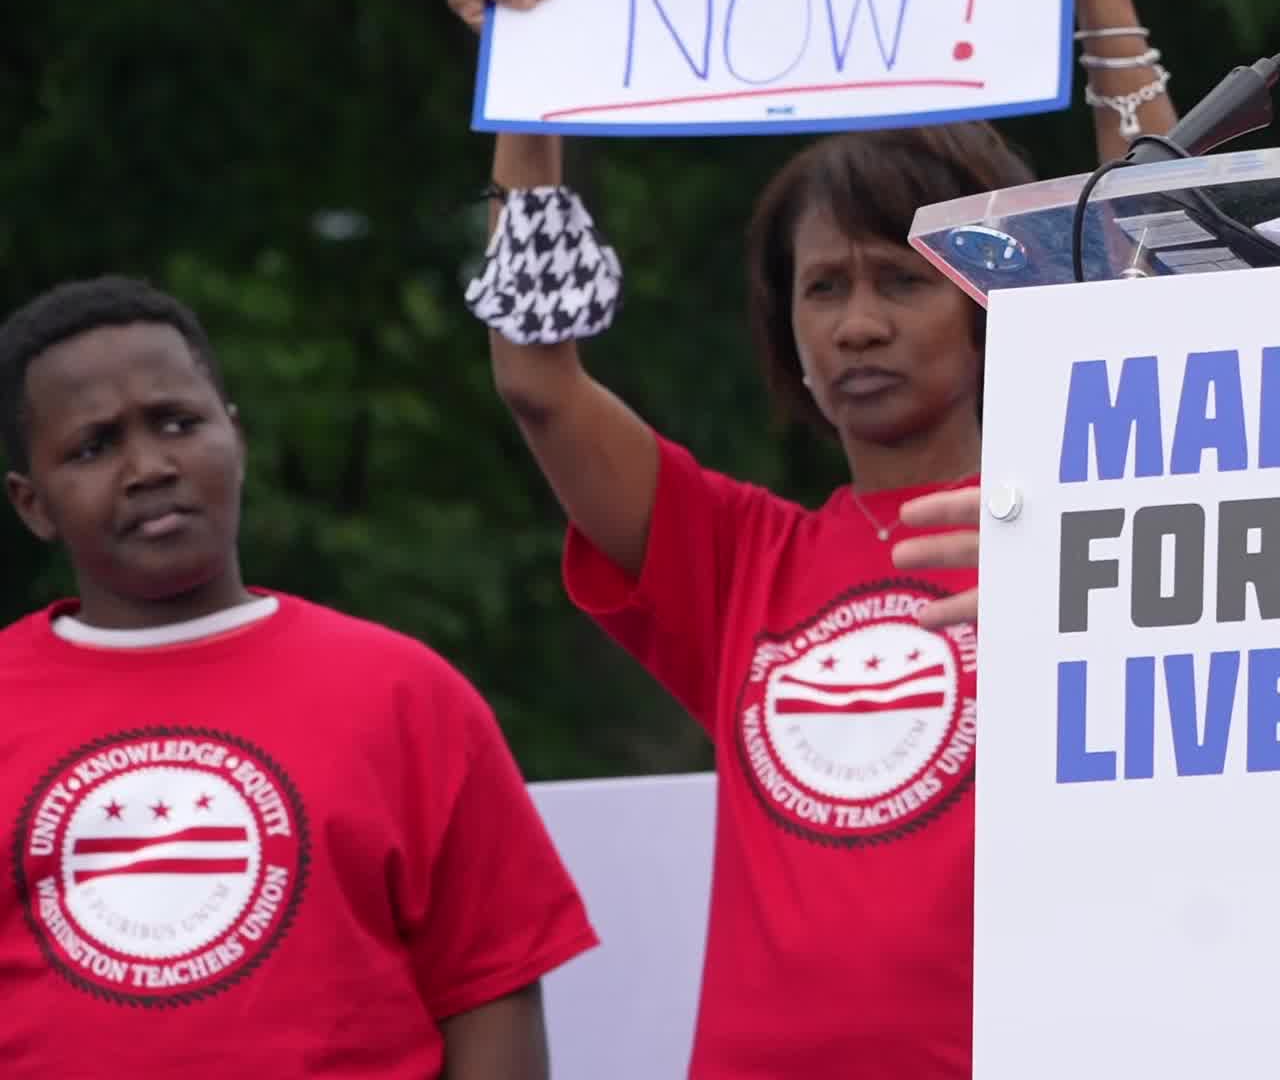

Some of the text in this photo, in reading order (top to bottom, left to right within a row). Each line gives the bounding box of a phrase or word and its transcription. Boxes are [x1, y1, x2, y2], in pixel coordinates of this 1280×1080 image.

[805, 594, 929, 642] KNOWLEDG
[30, 740, 291, 856] UNITY KNOWLEDGE EQUITY
[36, 875, 130, 985] WASHINGTON
[238, 864, 289, 941] UNION
